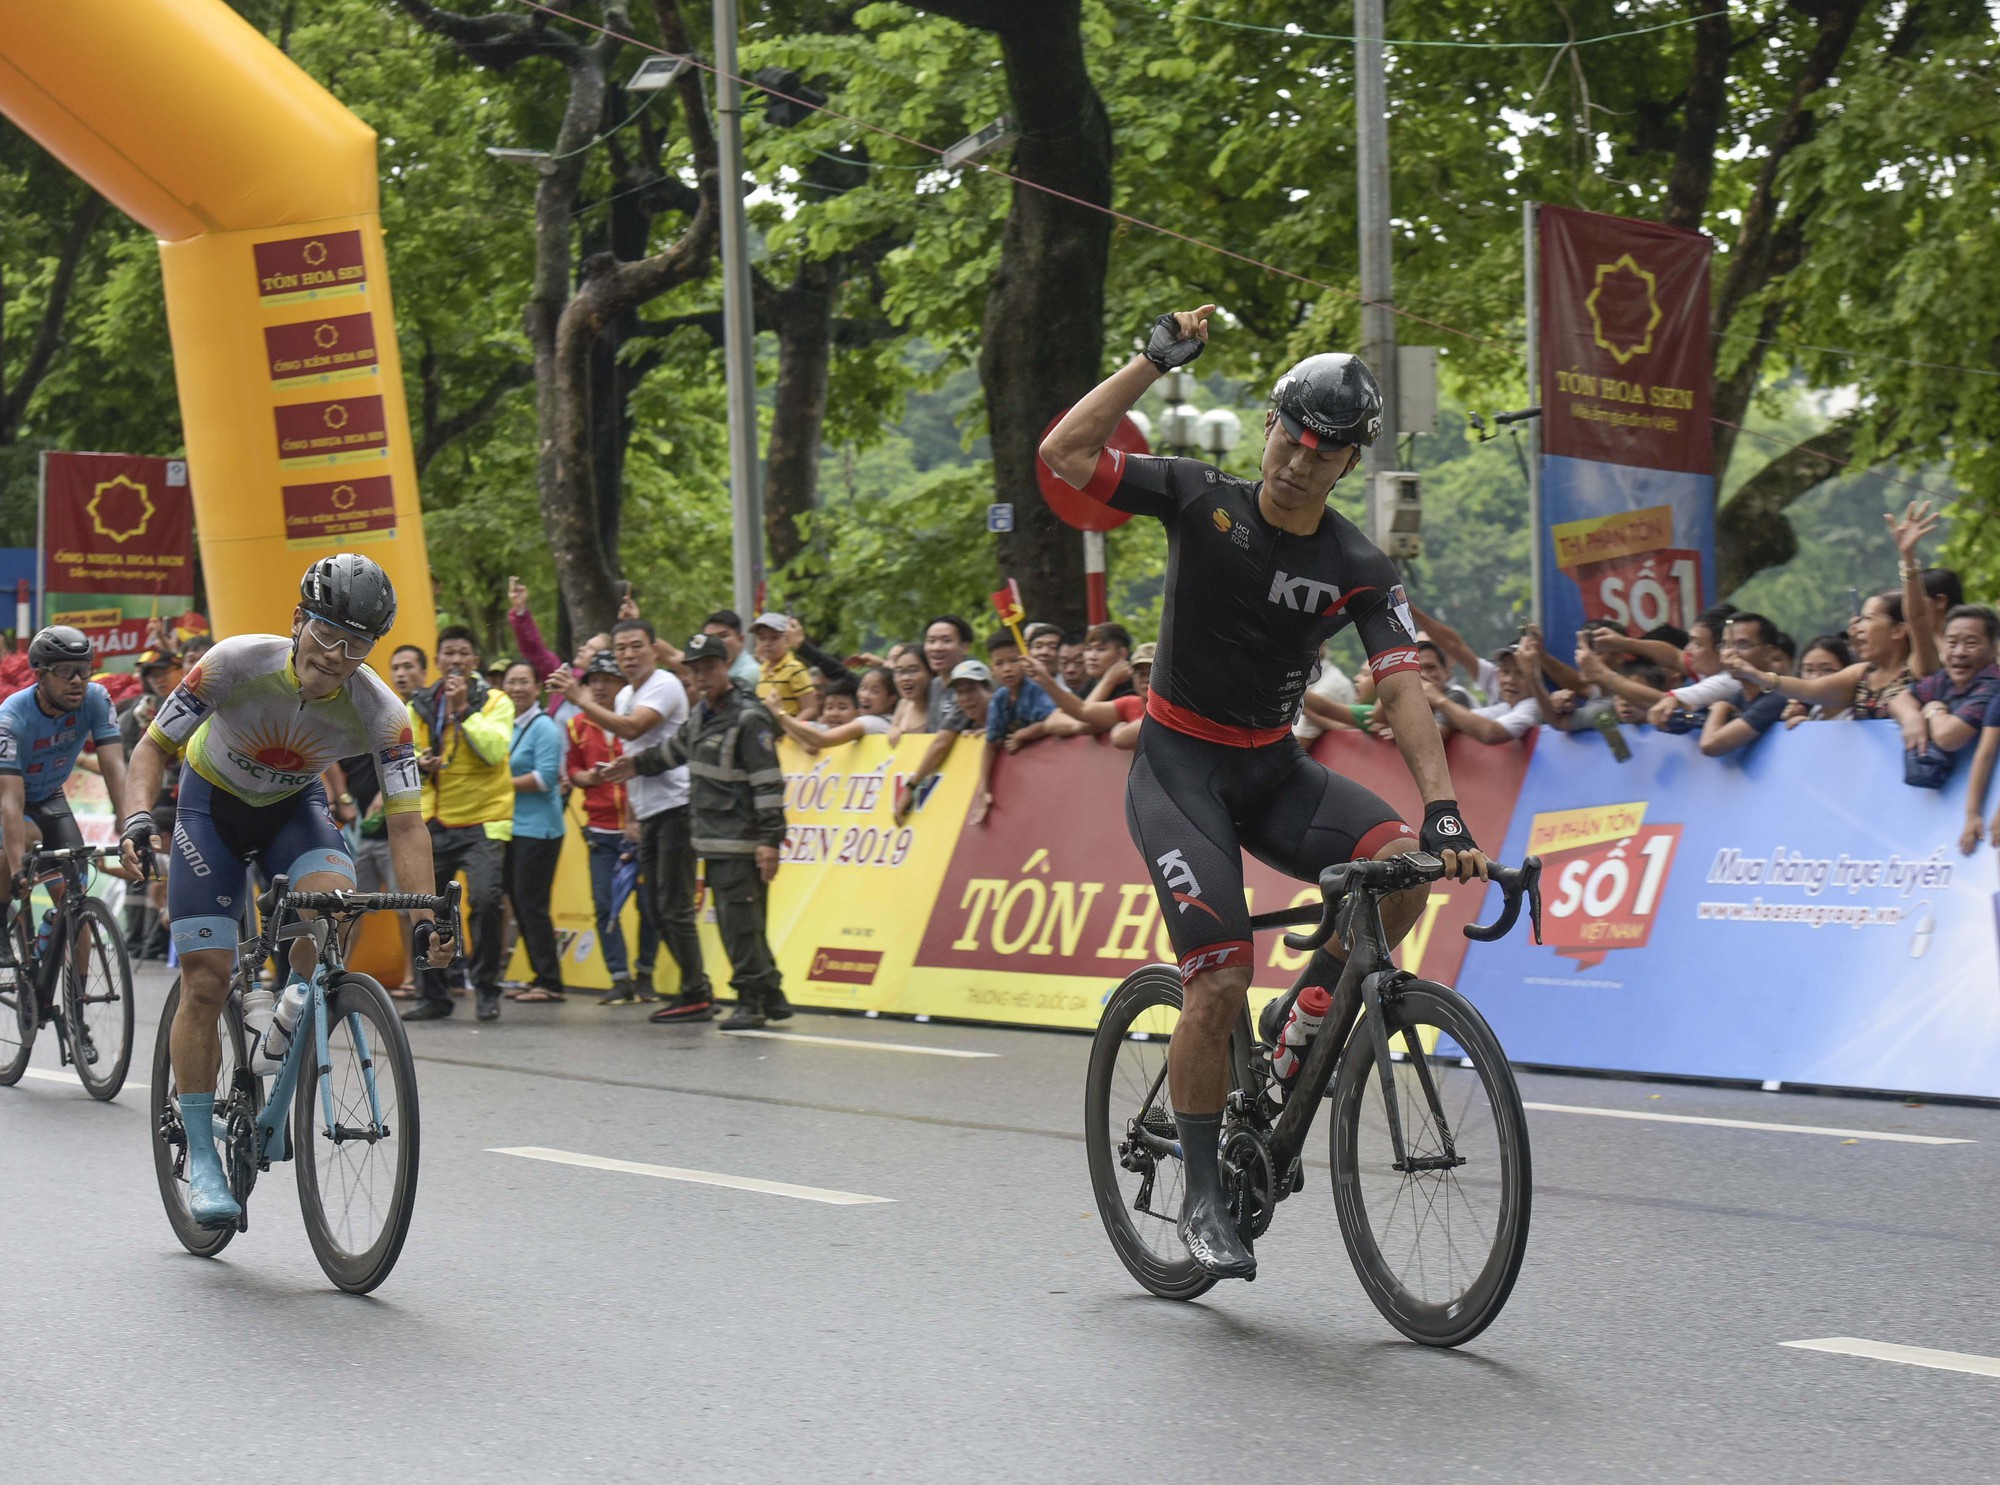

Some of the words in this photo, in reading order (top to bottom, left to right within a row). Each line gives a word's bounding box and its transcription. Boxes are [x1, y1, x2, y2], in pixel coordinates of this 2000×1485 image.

[261, 272, 299, 291] TÔN
[301, 269, 336, 286] HOA
[337, 265, 364, 280] SEN
[1600, 378, 1647, 404] HOA
[1649, 386, 1694, 410] SEN
[1302, 415, 1337, 437] RUDY
[1230, 534, 1251, 551] TOUR
[1232, 528, 1250, 543] ASIA
[1235, 521, 1251, 536] UCI
[1600, 559, 1670, 633] SỐ
[344, 619, 368, 631] LAZER
[92, 628, 138, 654] HÂU
[1371, 650, 1419, 673] FEL
[157, 698, 188, 728] 17
[784, 757, 840, 813] UỐC
[837, 826, 915, 867] 2019
[1549, 838, 1632, 918] SỐ
[1632, 835, 1674, 915] 1
[1706, 848, 1768, 885] Mua
[1765, 846, 1832, 897] hàng
[952, 848, 1105, 957] TÔN
[1698, 897, 1901, 929] www.hoasengroup.vn
